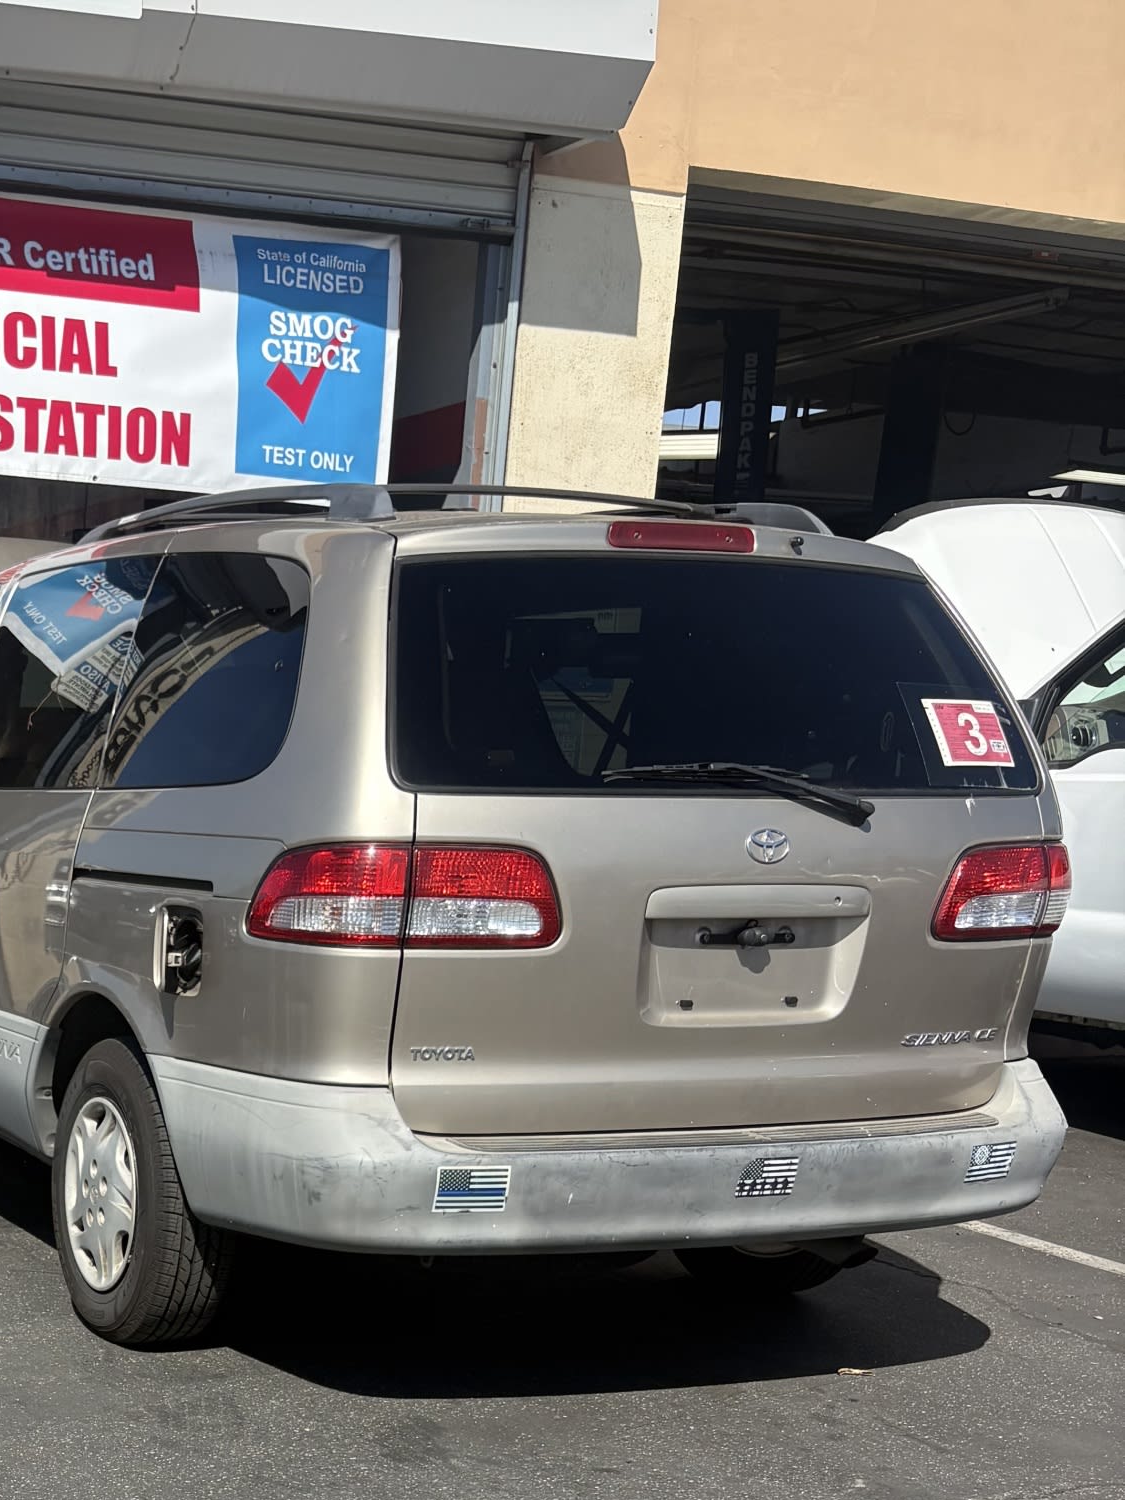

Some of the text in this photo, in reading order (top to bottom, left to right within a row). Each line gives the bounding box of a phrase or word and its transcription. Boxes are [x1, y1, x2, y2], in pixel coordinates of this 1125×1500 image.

[23, 240, 155, 281] Certified
[257, 248, 366, 274] State of California
[263, 262, 364, 295] LICENSED
[269, 310, 354, 344] SMOG
[260, 339, 361, 374] CHECK
[736, 352, 759, 470] BENDPAK
[262, 444, 354, 473] TEST ONLY
[957, 712, 988, 756] 3
[410, 1047, 475, 1061] TOYOTA
[900, 1031, 971, 1047] SIENNA
